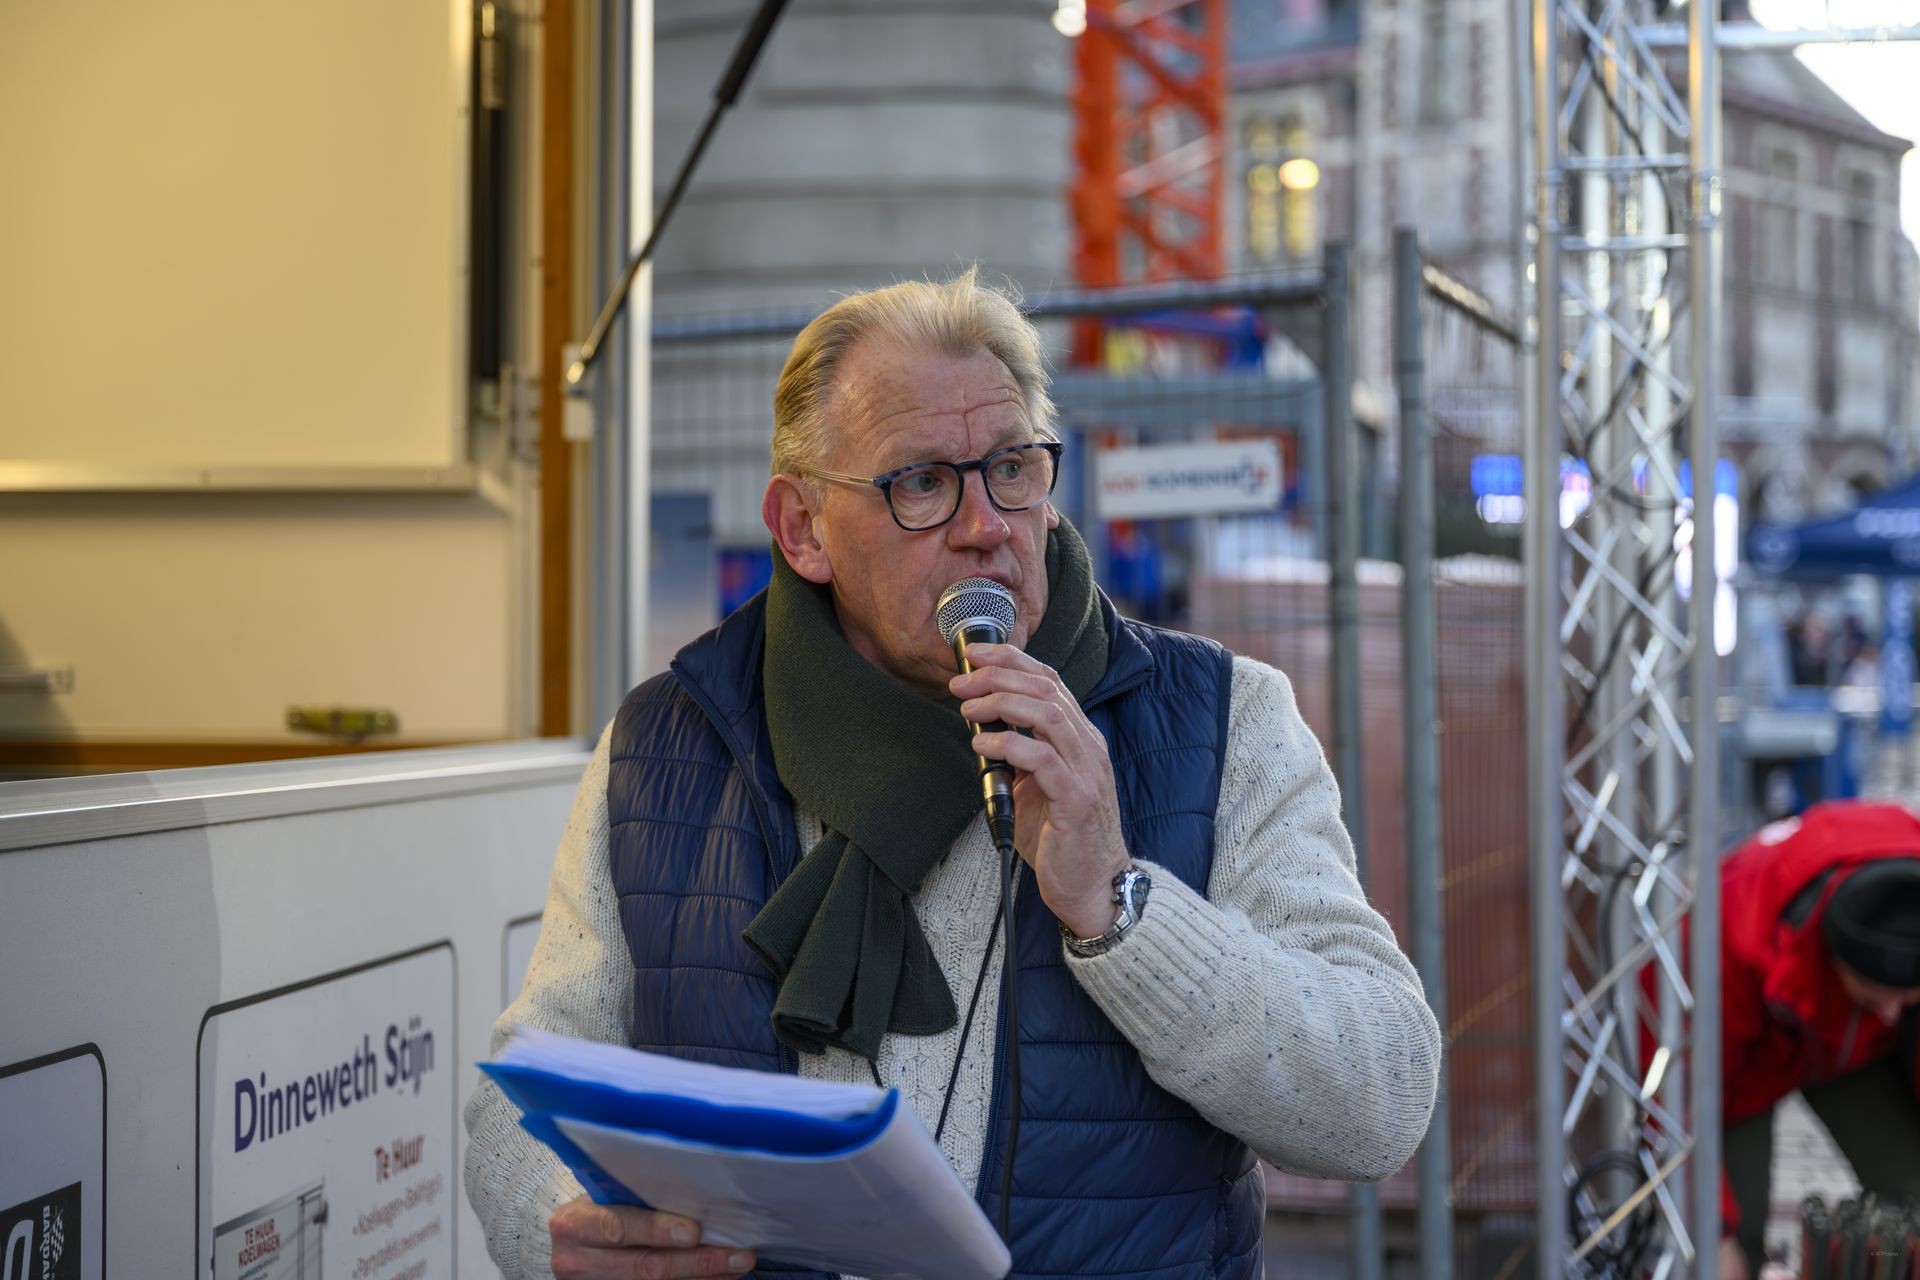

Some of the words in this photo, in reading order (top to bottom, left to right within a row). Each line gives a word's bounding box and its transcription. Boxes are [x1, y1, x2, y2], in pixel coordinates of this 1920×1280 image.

[234, 1034, 378, 1154] Dinneweth
[385, 1015, 435, 1095] Stijn
[374, 1145, 390, 1184] Te
[391, 1133, 425, 1176] Huur
[244, 1227, 254, 1246] TE
